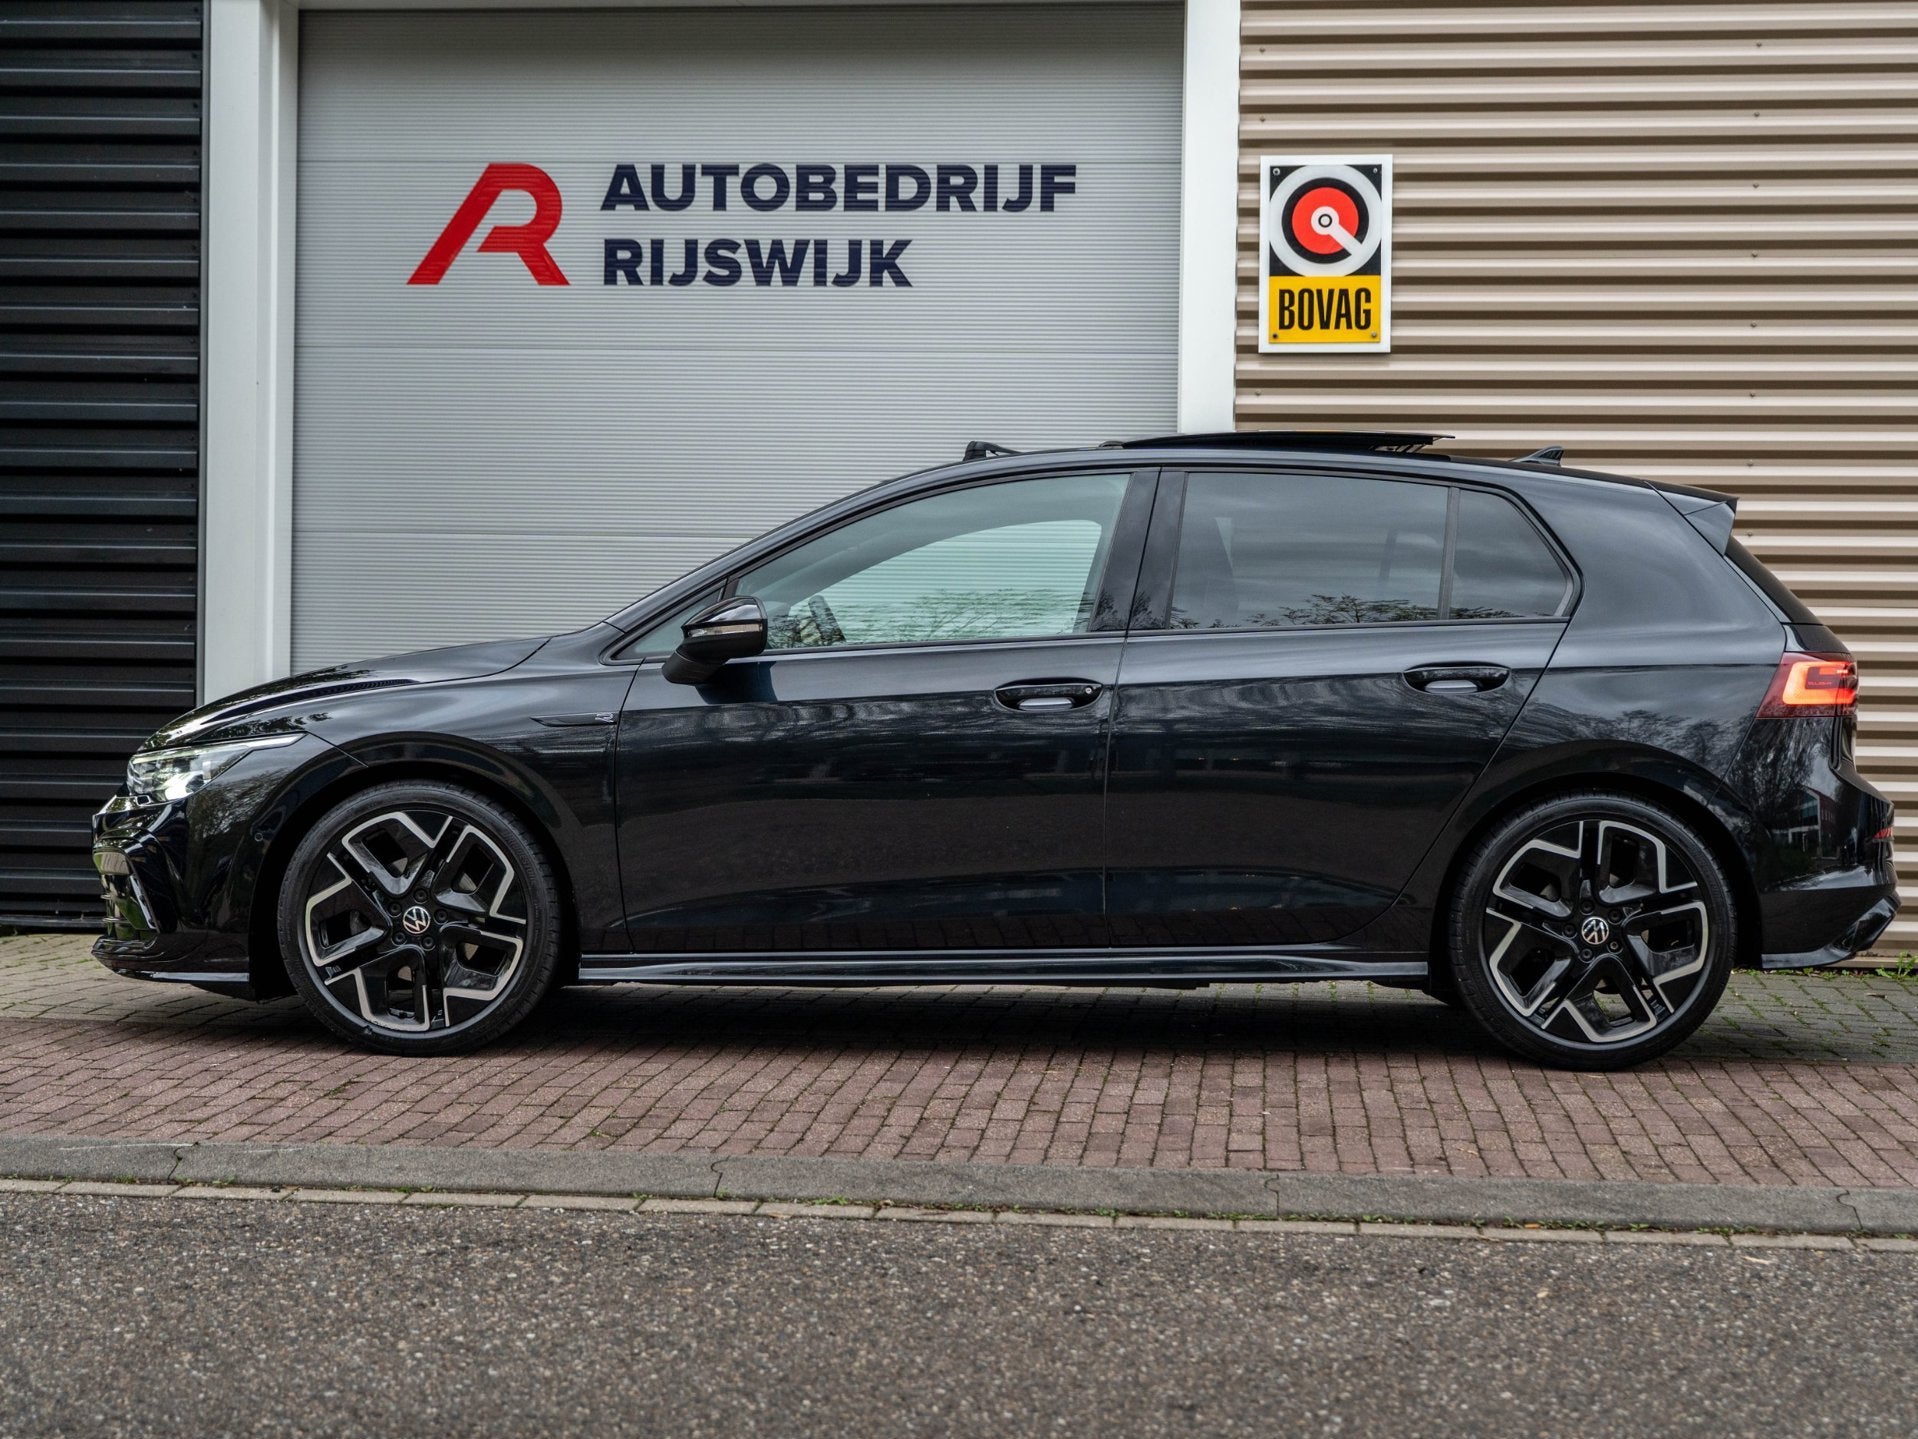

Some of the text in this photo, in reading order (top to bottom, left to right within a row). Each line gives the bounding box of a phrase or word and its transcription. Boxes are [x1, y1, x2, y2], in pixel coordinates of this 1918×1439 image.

[600, 163, 1077, 213] AUTOBEDRIJF
[603, 238, 914, 288] RIJSWIJK
[1278, 287, 1372, 331] BOVAG
